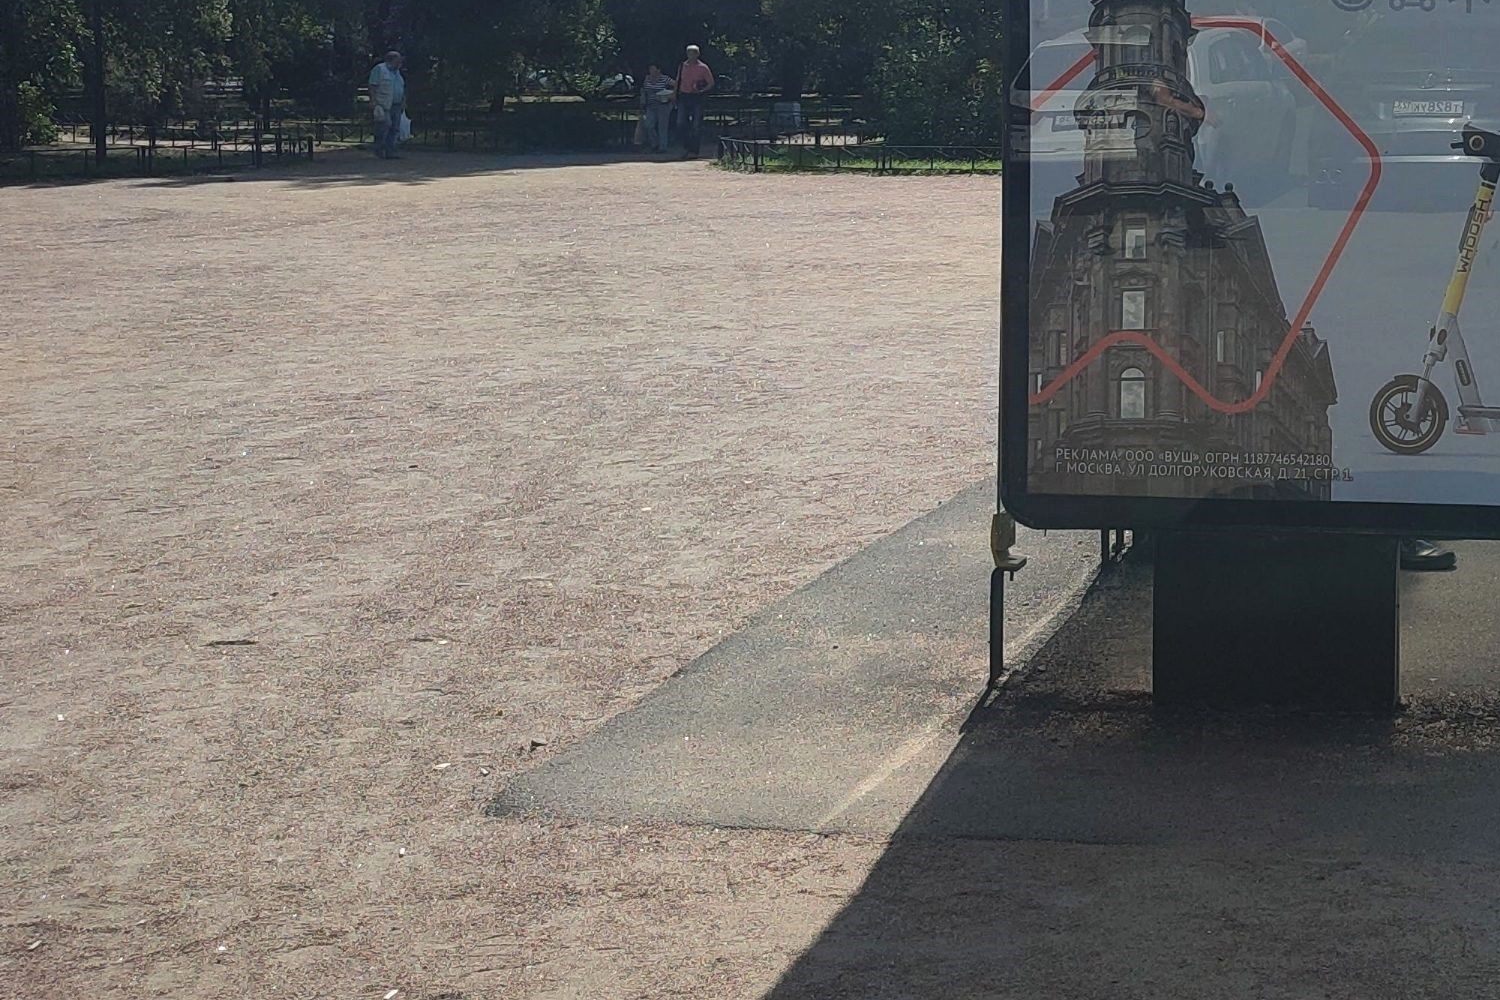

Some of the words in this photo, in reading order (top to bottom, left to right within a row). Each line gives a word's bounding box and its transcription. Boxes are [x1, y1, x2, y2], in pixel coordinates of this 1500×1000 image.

[1457, 199, 1492, 273] WHOOSH
[1125, 450, 1154, 461] ООО
[1205, 452, 1239, 464] ОГРН
[1148, 464, 1275, 480] ДОЛГОРУКОВСКАЯ,
